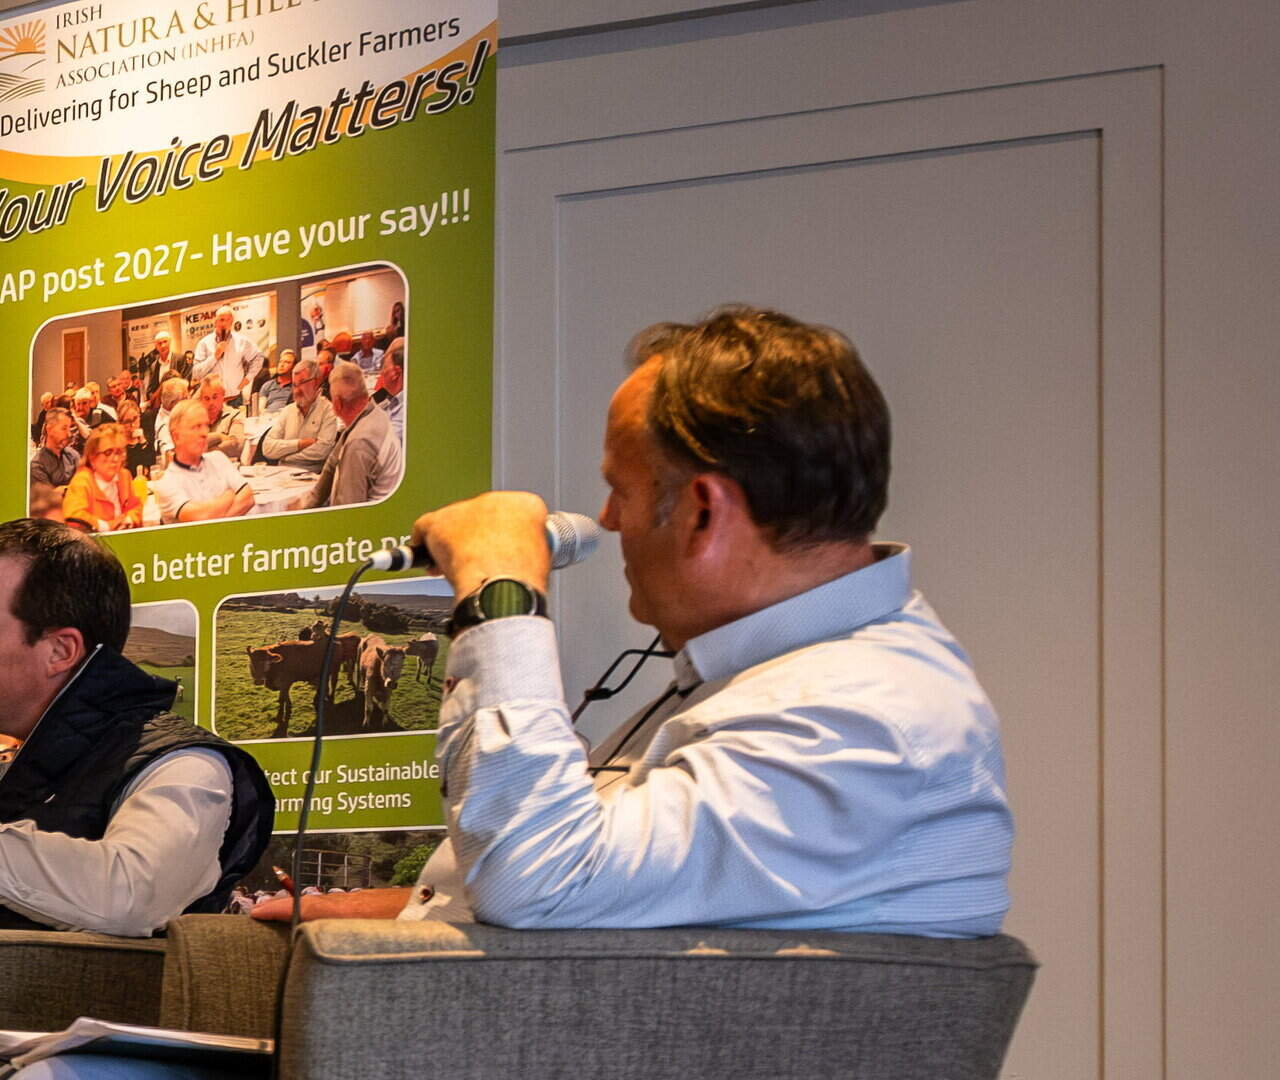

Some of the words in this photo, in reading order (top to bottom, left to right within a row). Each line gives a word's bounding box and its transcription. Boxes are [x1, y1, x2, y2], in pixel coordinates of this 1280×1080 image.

[55, 4, 103, 29] IRISH
[56, 10, 187, 64] NATURA
[193, 1, 216, 30] &
[0, 100, 103, 137] Delivering
[109, 88, 140, 112] for
[146, 70, 211, 104] Sheep
[218, 57, 260, 87] and
[267, 39, 353, 78] Suckler
[359, 17, 461, 57] Farmers
[56, 46, 177, 89] ASSOCIATION
[181, 30, 255, 60] (INHFA)
[94, 135, 231, 212] Voice
[238, 38, 490, 170] Matters!
[43, 256, 105, 304] post
[113, 241, 204, 282] 2027-
[212, 231, 291, 267] Have
[298, 213, 371, 260] your
[379, 188, 472, 237] say!!!
[131, 562, 145, 584] a
[152, 552, 235, 581] better
[241, 536, 373, 574] farmgate
[337, 760, 439, 783] Sustainable
[337, 791, 412, 814] Systems
